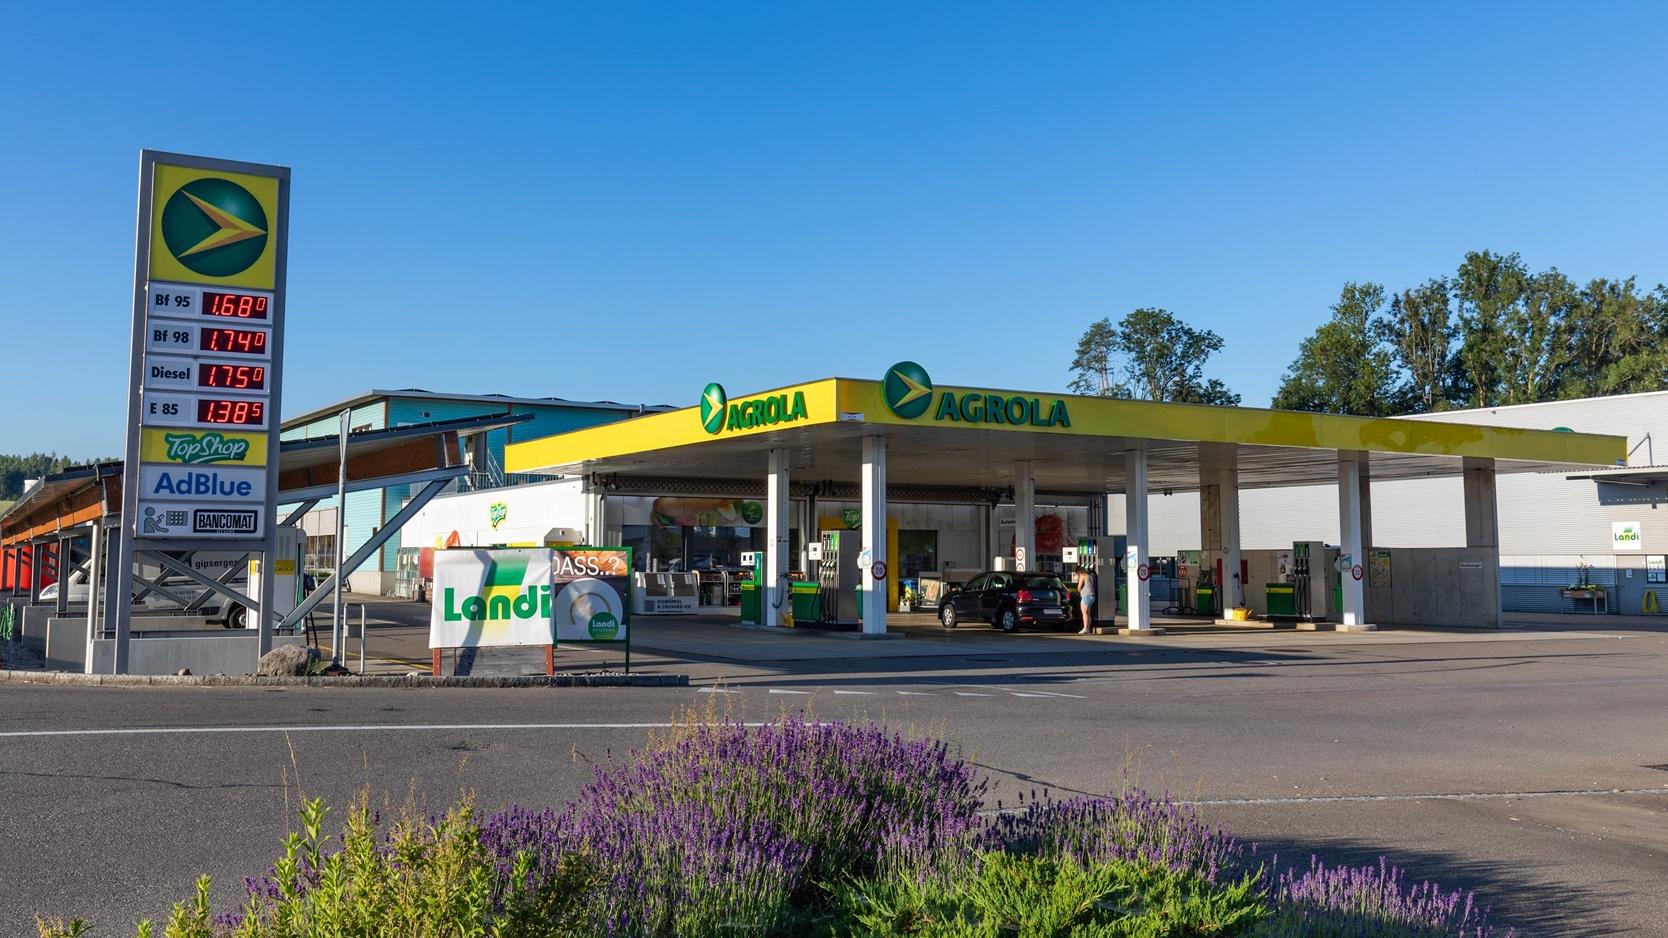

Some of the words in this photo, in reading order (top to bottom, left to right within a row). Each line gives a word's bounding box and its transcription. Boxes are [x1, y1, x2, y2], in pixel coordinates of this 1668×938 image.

[155, 294, 170, 307] Bf
[174, 295, 190, 308] 95
[153, 330, 169, 343] Bf
[173, 331, 190, 344] 98
[151, 366, 191, 380] Diesel
[149, 403, 157, 414] E
[162, 403, 179, 415] 85
[726, 391, 808, 430] AGROLA
[935, 391, 1071, 428] AGROLA
[169, 436, 245, 460] TopShop
[153, 472, 252, 497] AdBlue
[198, 513, 254, 529] BANCOMAT
[1614, 532, 1640, 541] Landi
[444, 584, 551, 622] Landi
[592, 619, 615, 628] Landi
